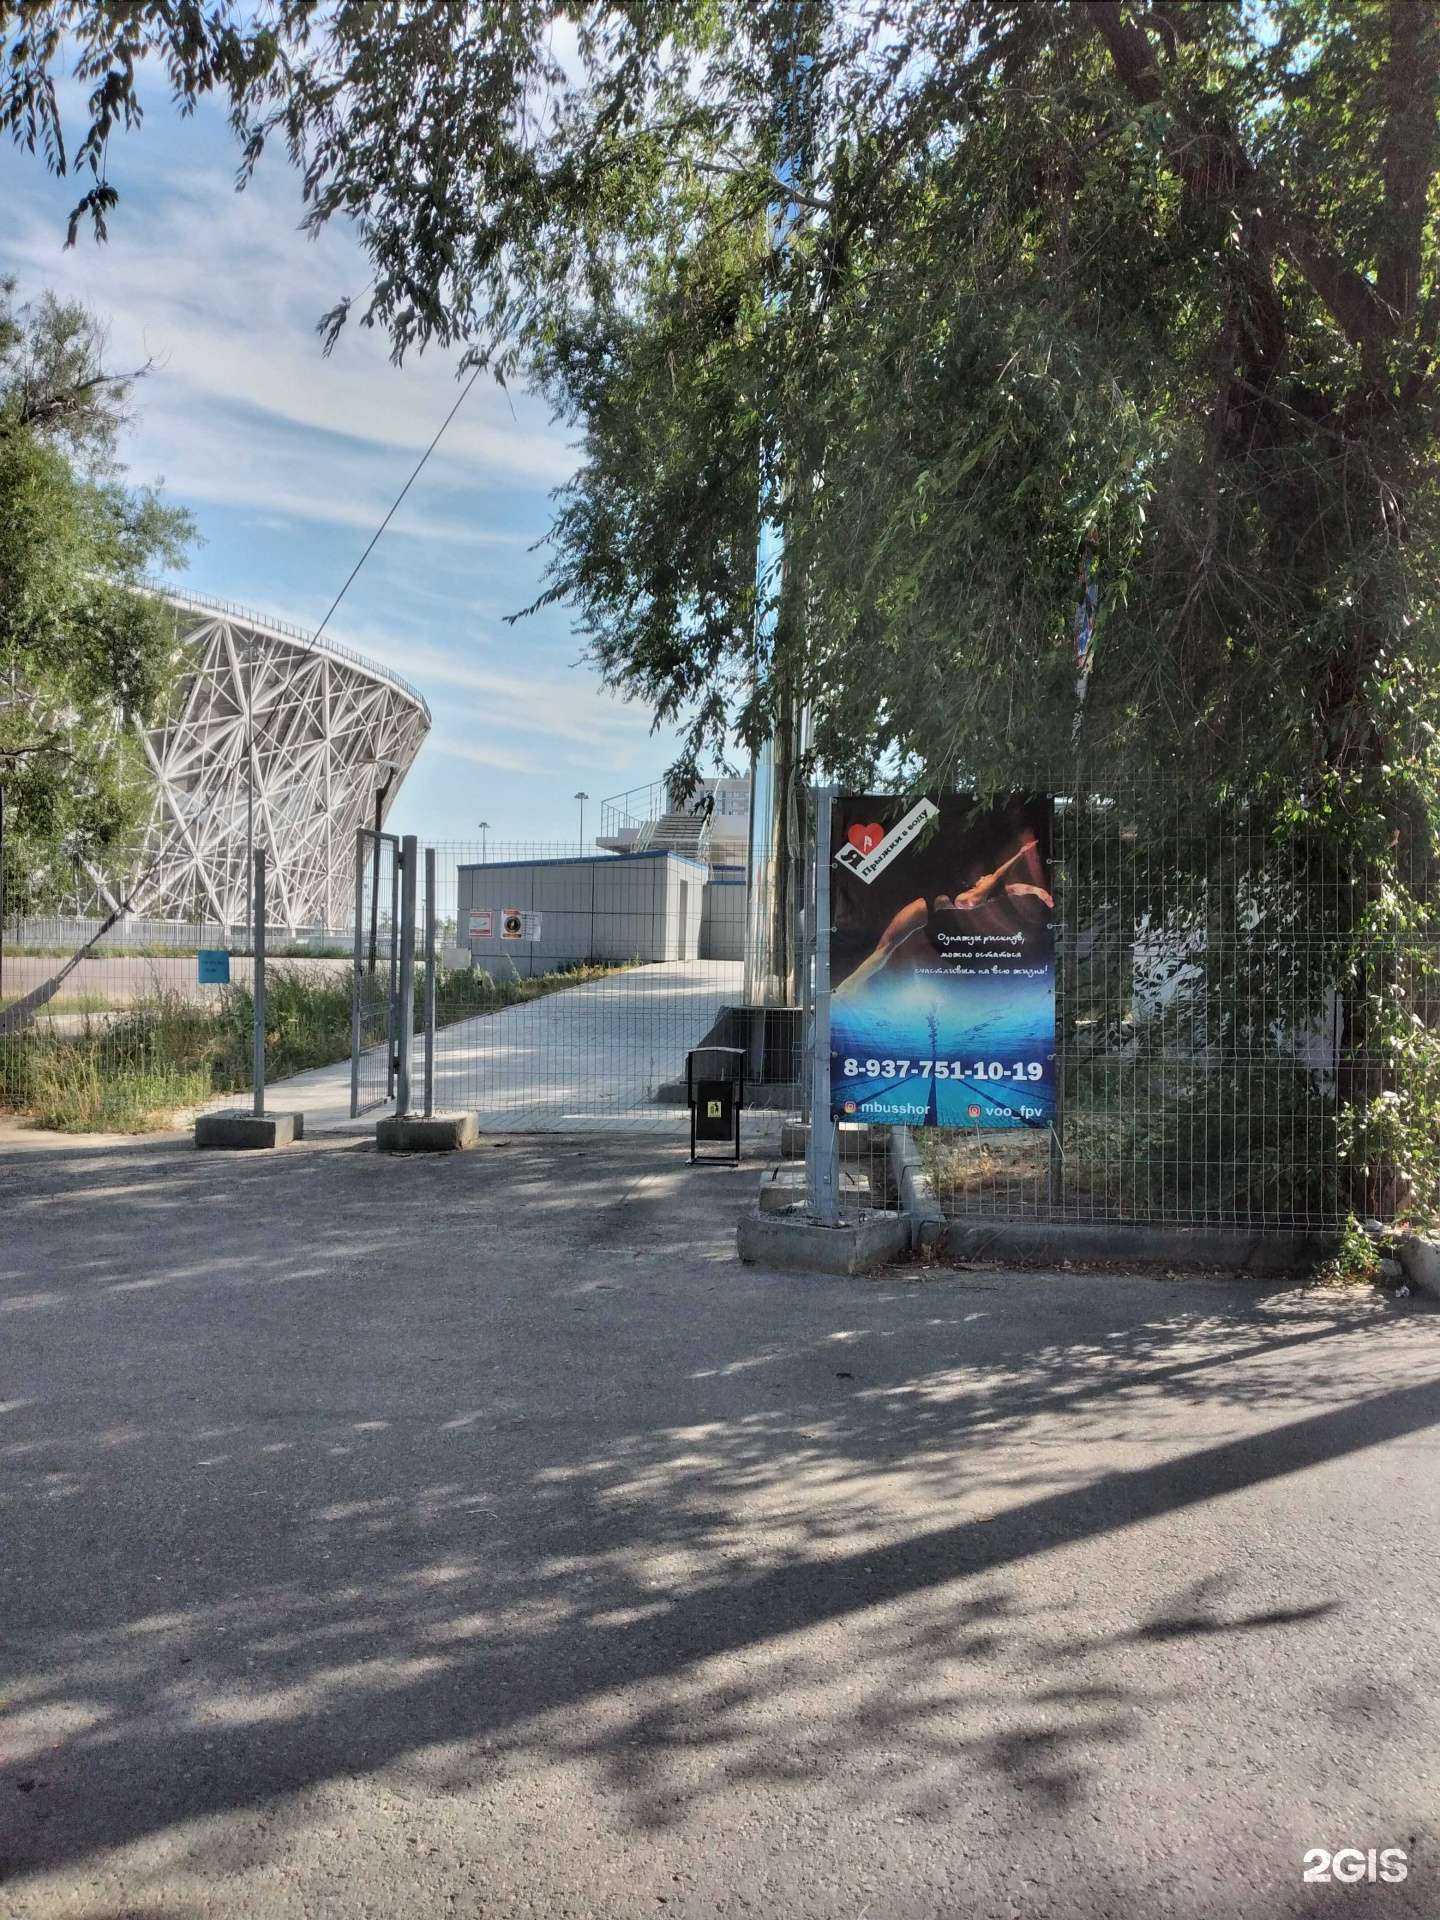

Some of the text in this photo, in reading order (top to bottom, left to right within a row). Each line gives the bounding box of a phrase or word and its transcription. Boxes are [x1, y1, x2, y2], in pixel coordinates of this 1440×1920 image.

[862, 836, 903, 876] Прыжки
[907, 809, 928, 830] воду
[937, 933, 982, 945] Однажды
[975, 950, 1022, 958] остаться
[843, 1058, 1043, 1081] 8-937-751-10-19
[861, 1101, 931, 1115] mbusshor
[985, 1104, 1043, 1119] voo_fpv
